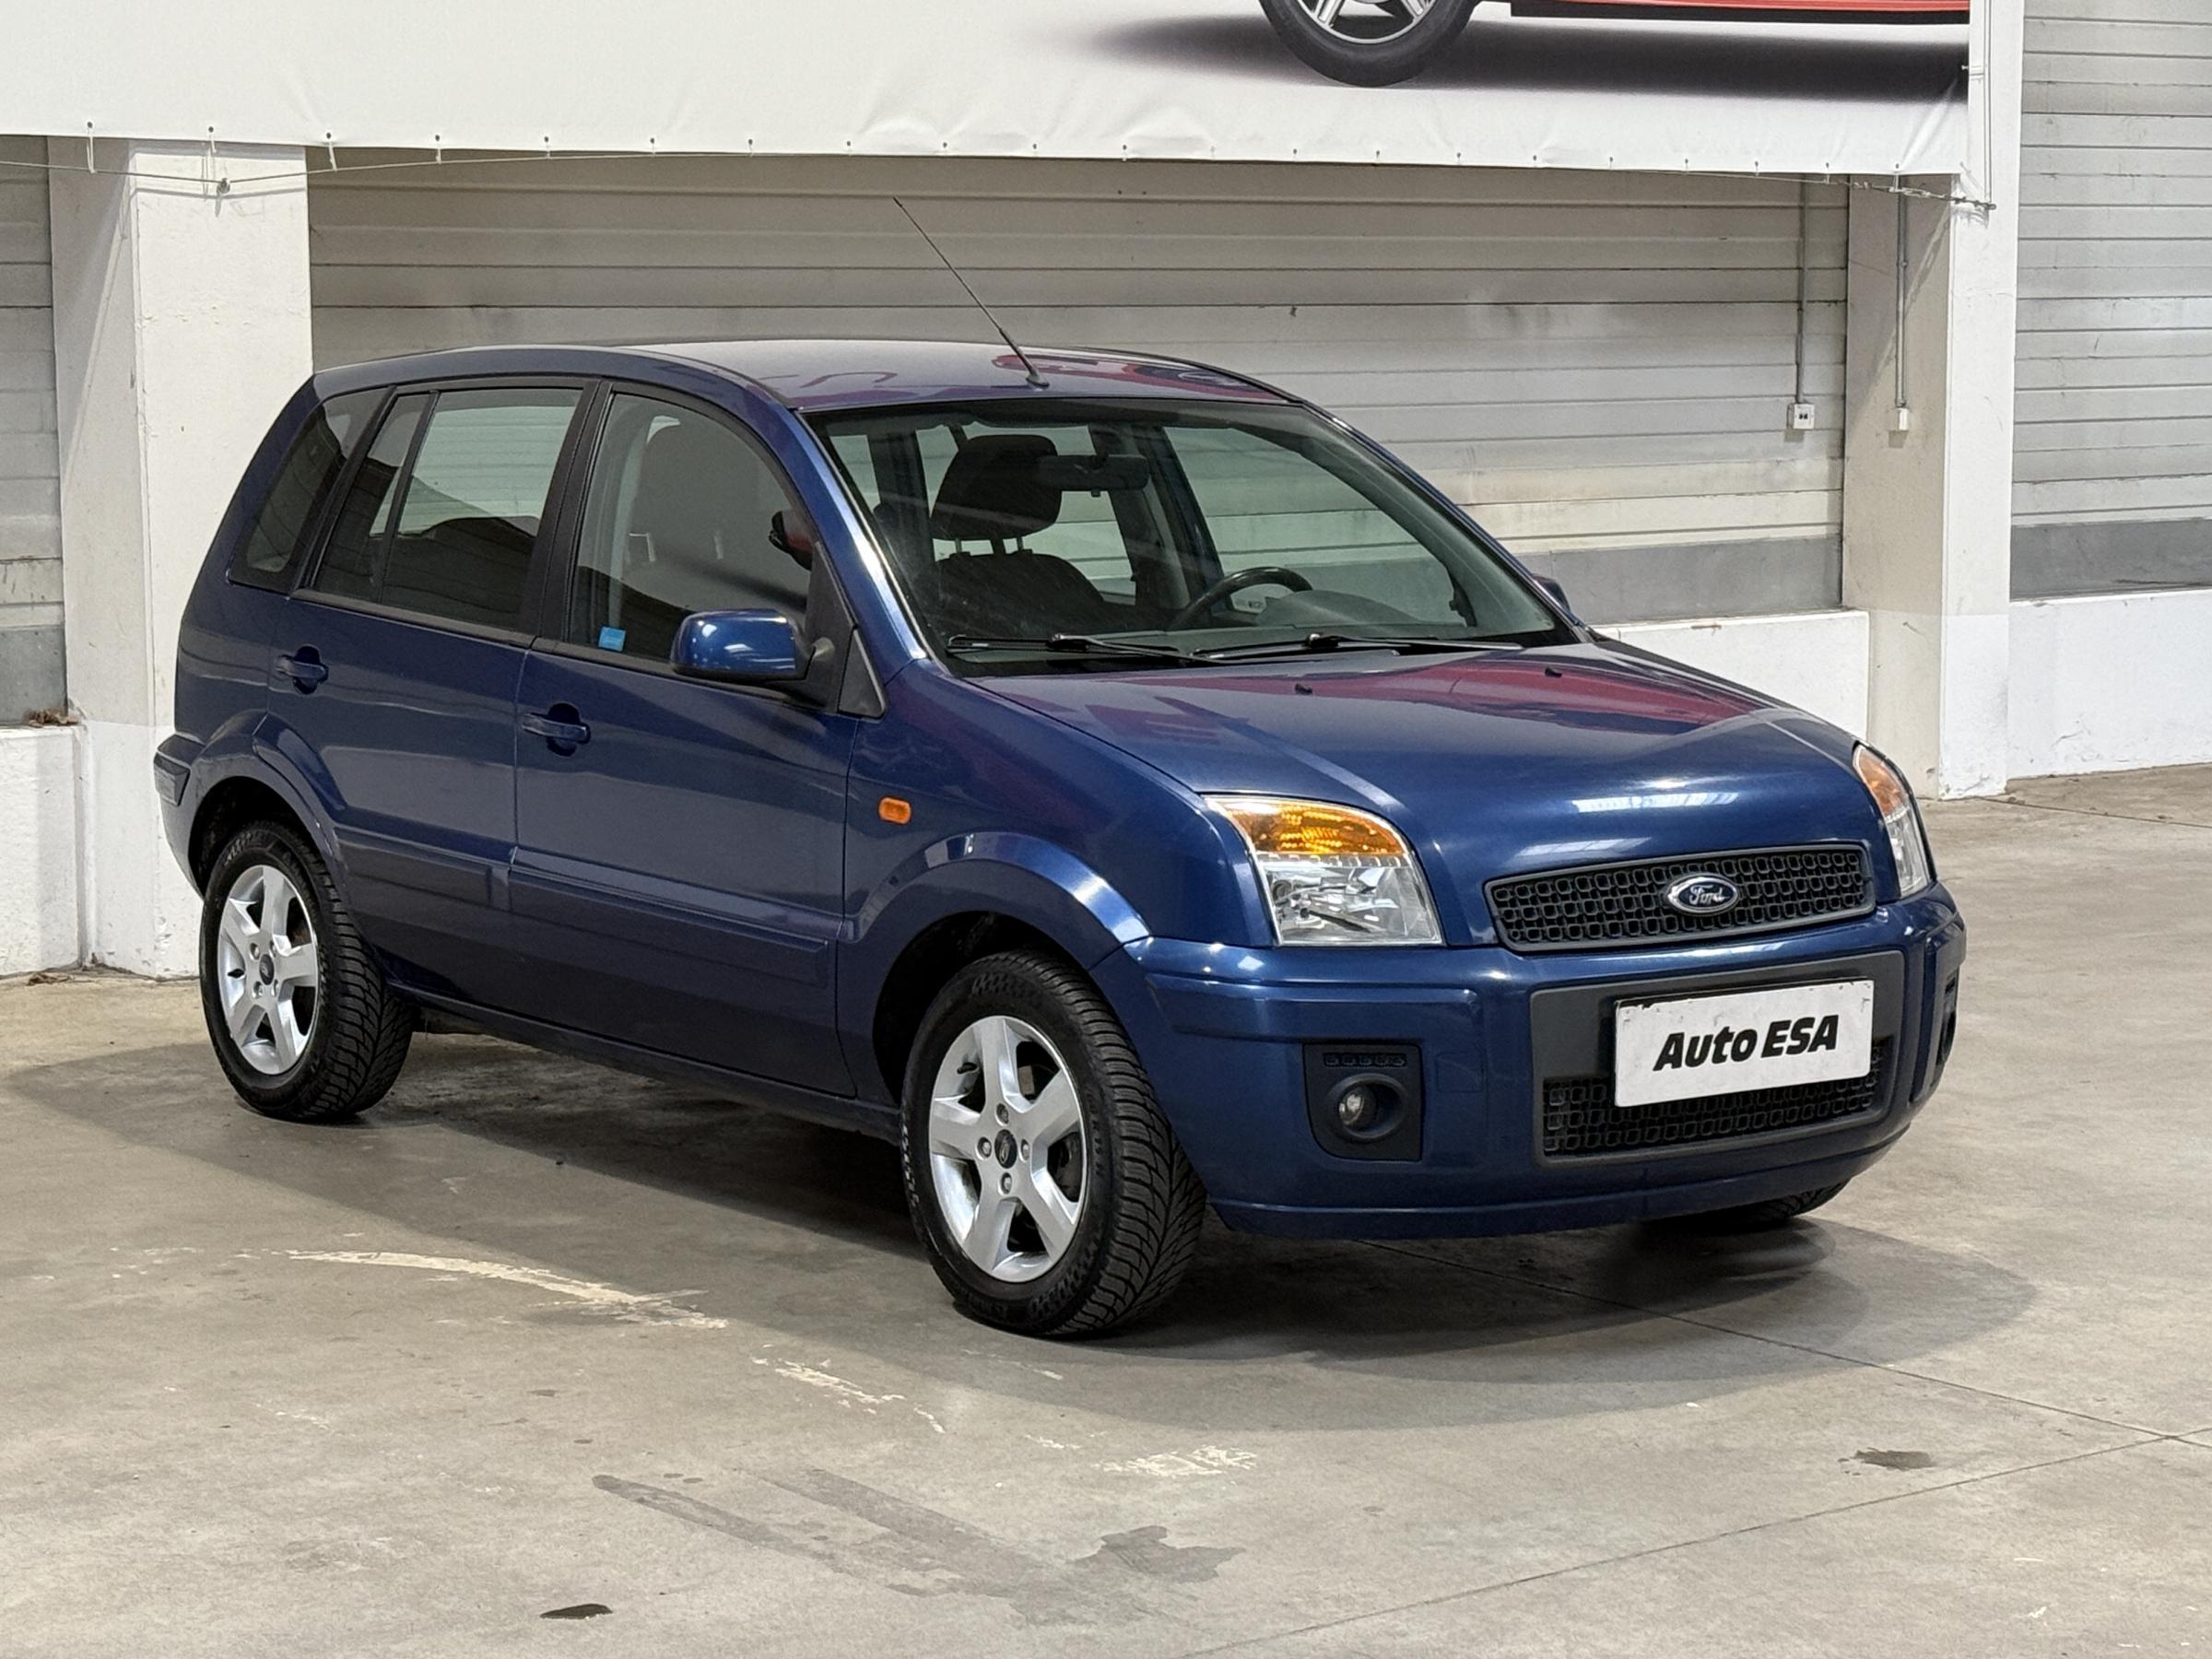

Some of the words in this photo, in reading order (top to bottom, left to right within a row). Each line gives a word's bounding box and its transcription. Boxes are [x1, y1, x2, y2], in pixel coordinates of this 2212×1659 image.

[1689, 884, 1729, 905] Ford
[1653, 1027, 1758, 1071] Auto
[1761, 1015, 1839, 1058] ESA
